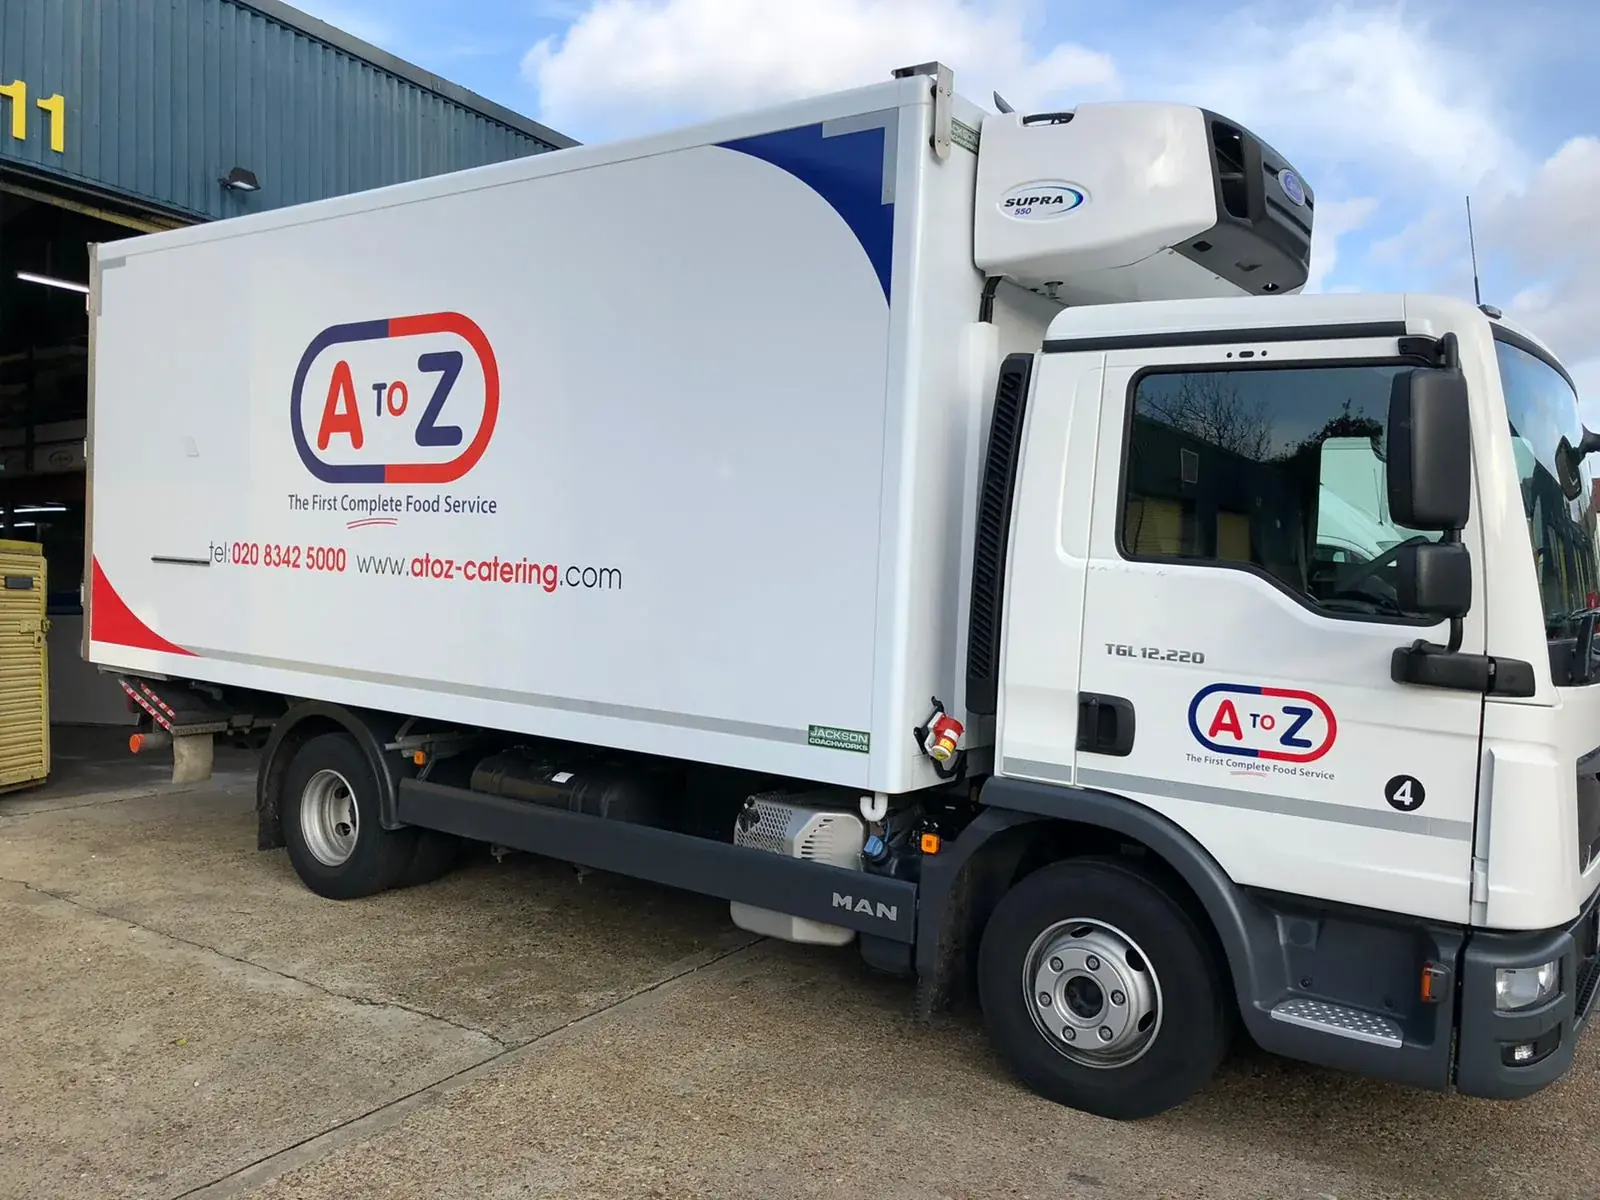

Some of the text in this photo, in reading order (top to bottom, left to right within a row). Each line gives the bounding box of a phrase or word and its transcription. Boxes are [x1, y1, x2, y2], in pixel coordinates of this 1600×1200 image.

[1004, 195, 1064, 207] SUPRA
[317, 360, 364, 450] A
[415, 351, 464, 446] Z
[288, 494, 497, 515] The First Complete Food Service
[264, 544, 300, 568] 8342
[306, 546, 346, 572] 5000
[356, 552, 622, 593] www.atoz-catering.com
[1105, 643, 1205, 664] TGL 12.220
[811, 726, 869, 744] JACKSON
[1208, 699, 1243, 741] A
[1279, 706, 1313, 748] Z
[809, 737, 869, 751] COACHWORKS
[1186, 753, 1335, 780] The First Complete Food Service
[1393, 780, 1413, 806] 4
[832, 892, 898, 921] MAN
